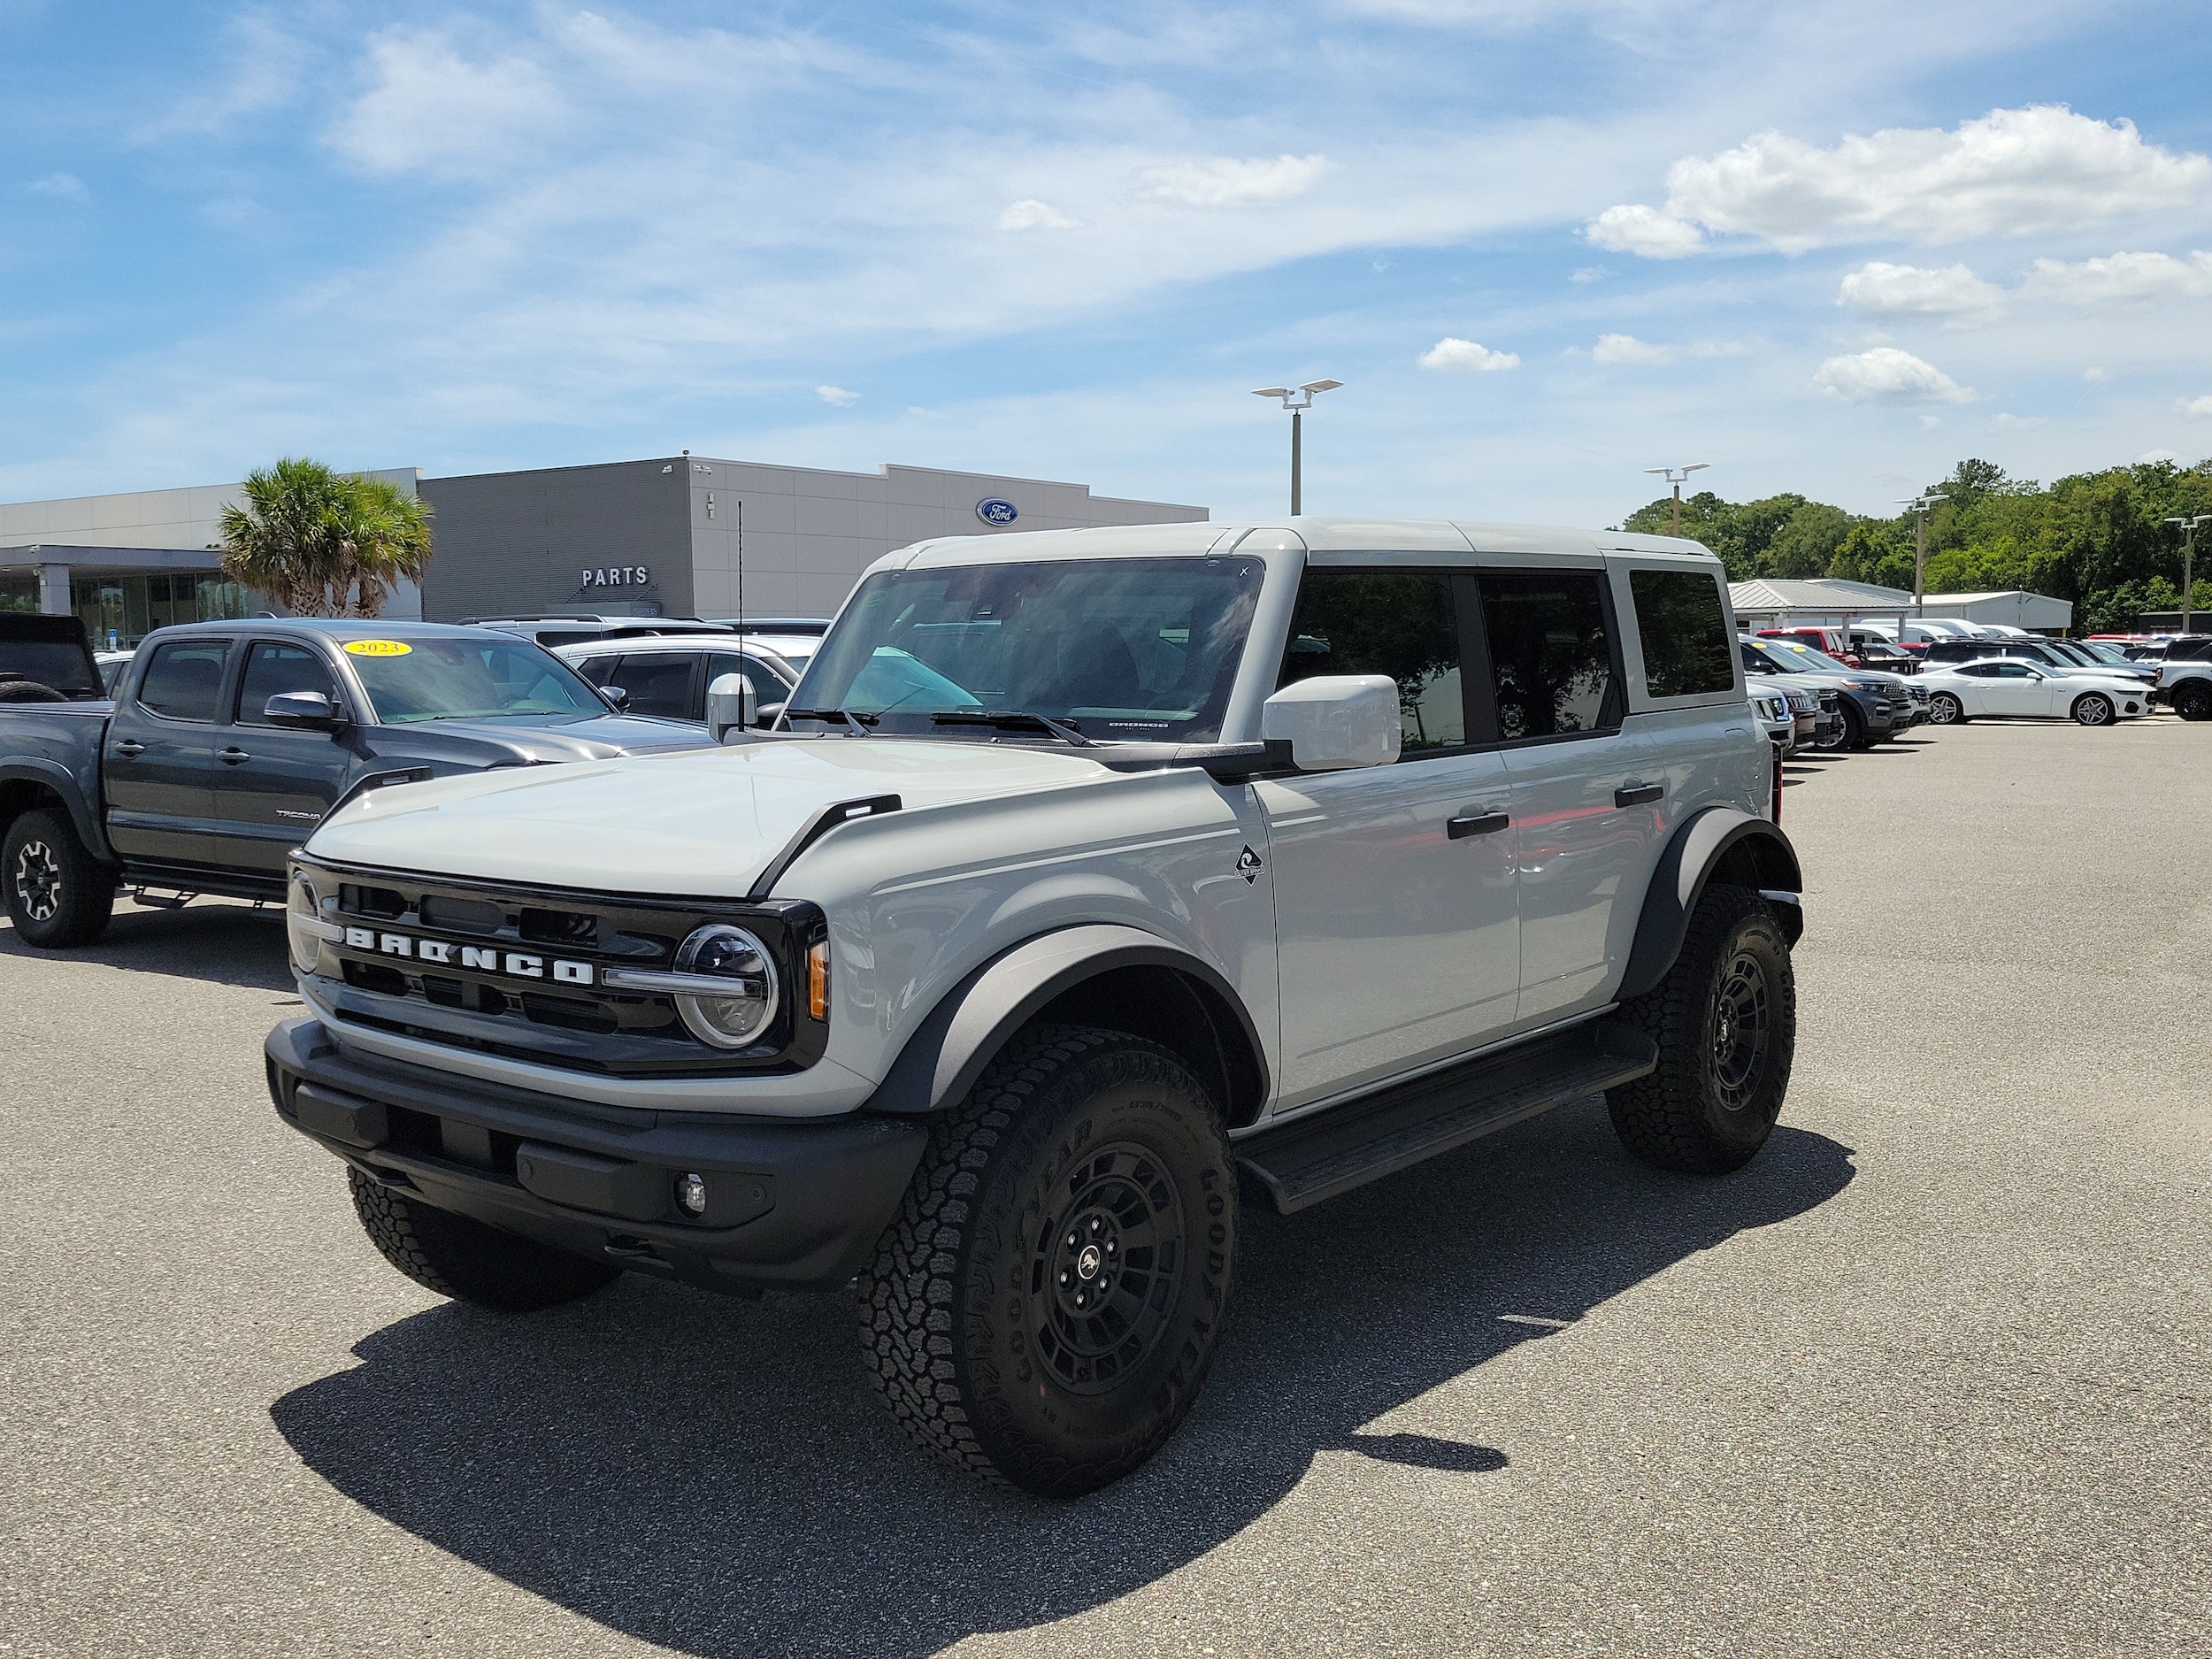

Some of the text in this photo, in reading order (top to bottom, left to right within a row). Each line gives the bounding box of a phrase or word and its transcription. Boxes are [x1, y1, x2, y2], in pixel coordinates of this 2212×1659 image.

[989, 503, 1012, 521] Ford
[581, 565, 648, 587] PARTS
[357, 641, 400, 653] 2023
[345, 926, 594, 986] BRONCO
